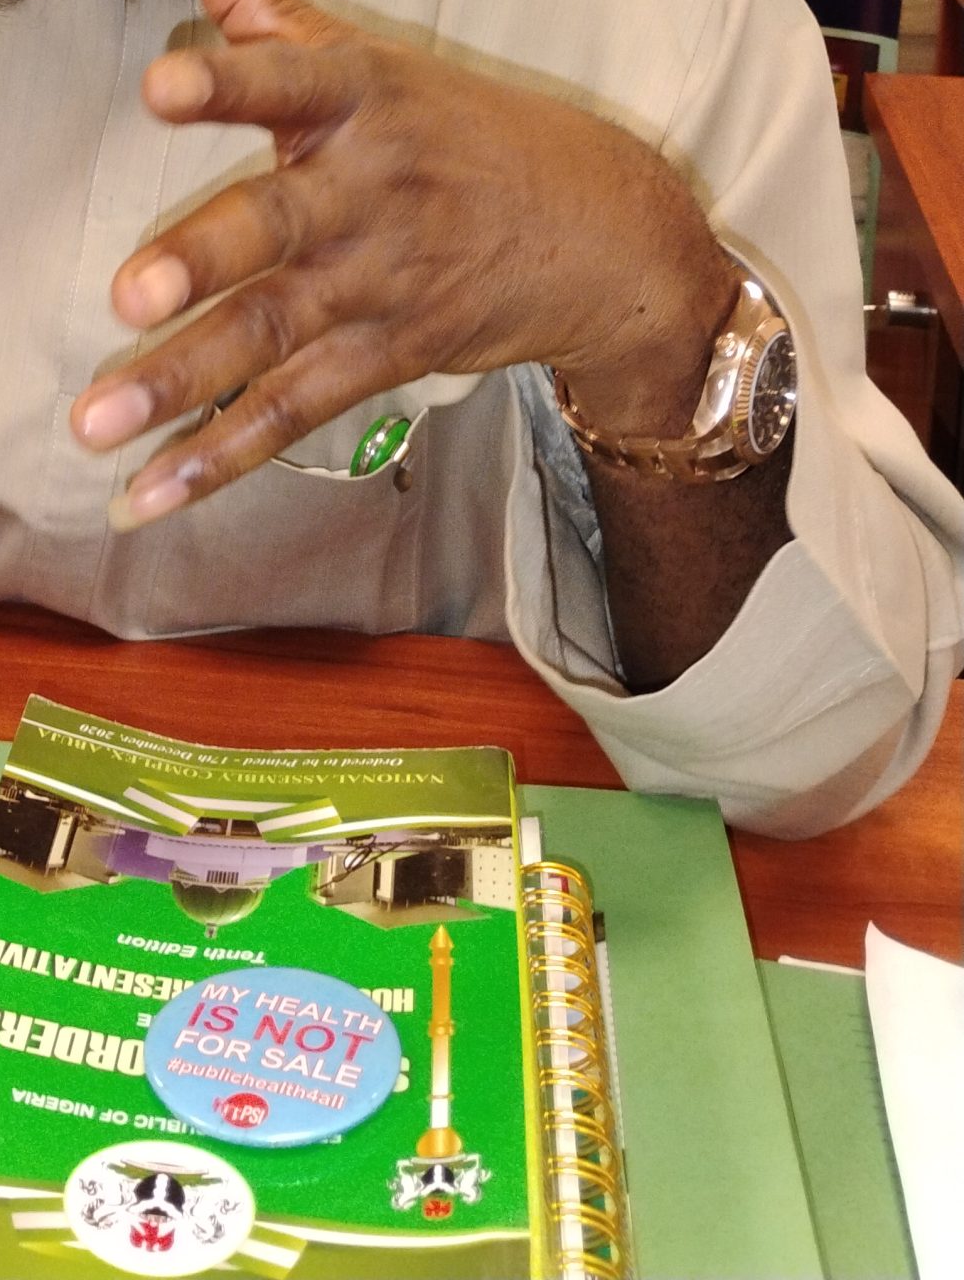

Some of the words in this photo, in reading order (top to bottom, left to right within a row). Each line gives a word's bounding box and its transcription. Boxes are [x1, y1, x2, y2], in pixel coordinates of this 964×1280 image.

[38, 727, 102, 754] ABUJA
[79, 723, 115, 741] 2020
[198, 753, 228, 765] 17th
[243, 757, 298, 768] Printed
[302, 758, 320, 767] be
[323, 758, 337, 767] to
[341, 757, 404, 767] Ordered
[222, 770, 330, 785] ASSEMBLY
[333, 773, 445, 785] NATIONAL
[117, 933, 197, 958] Edition
[203, 946, 266, 965] Tenth
[202, 984, 250, 1004] MY
[255, 992, 384, 1035] HEALTH
[188, 1002, 239, 1033] IS
[253, 1014, 374, 1062] NOT
[174, 1030, 252, 1062] FOR
[261, 1048, 362, 1088] SALE
[167, 1058, 344, 1110] #publichealth4all
[12, 1088, 94, 1118] NIGERIA
[100, 1110, 128, 1126] OF
